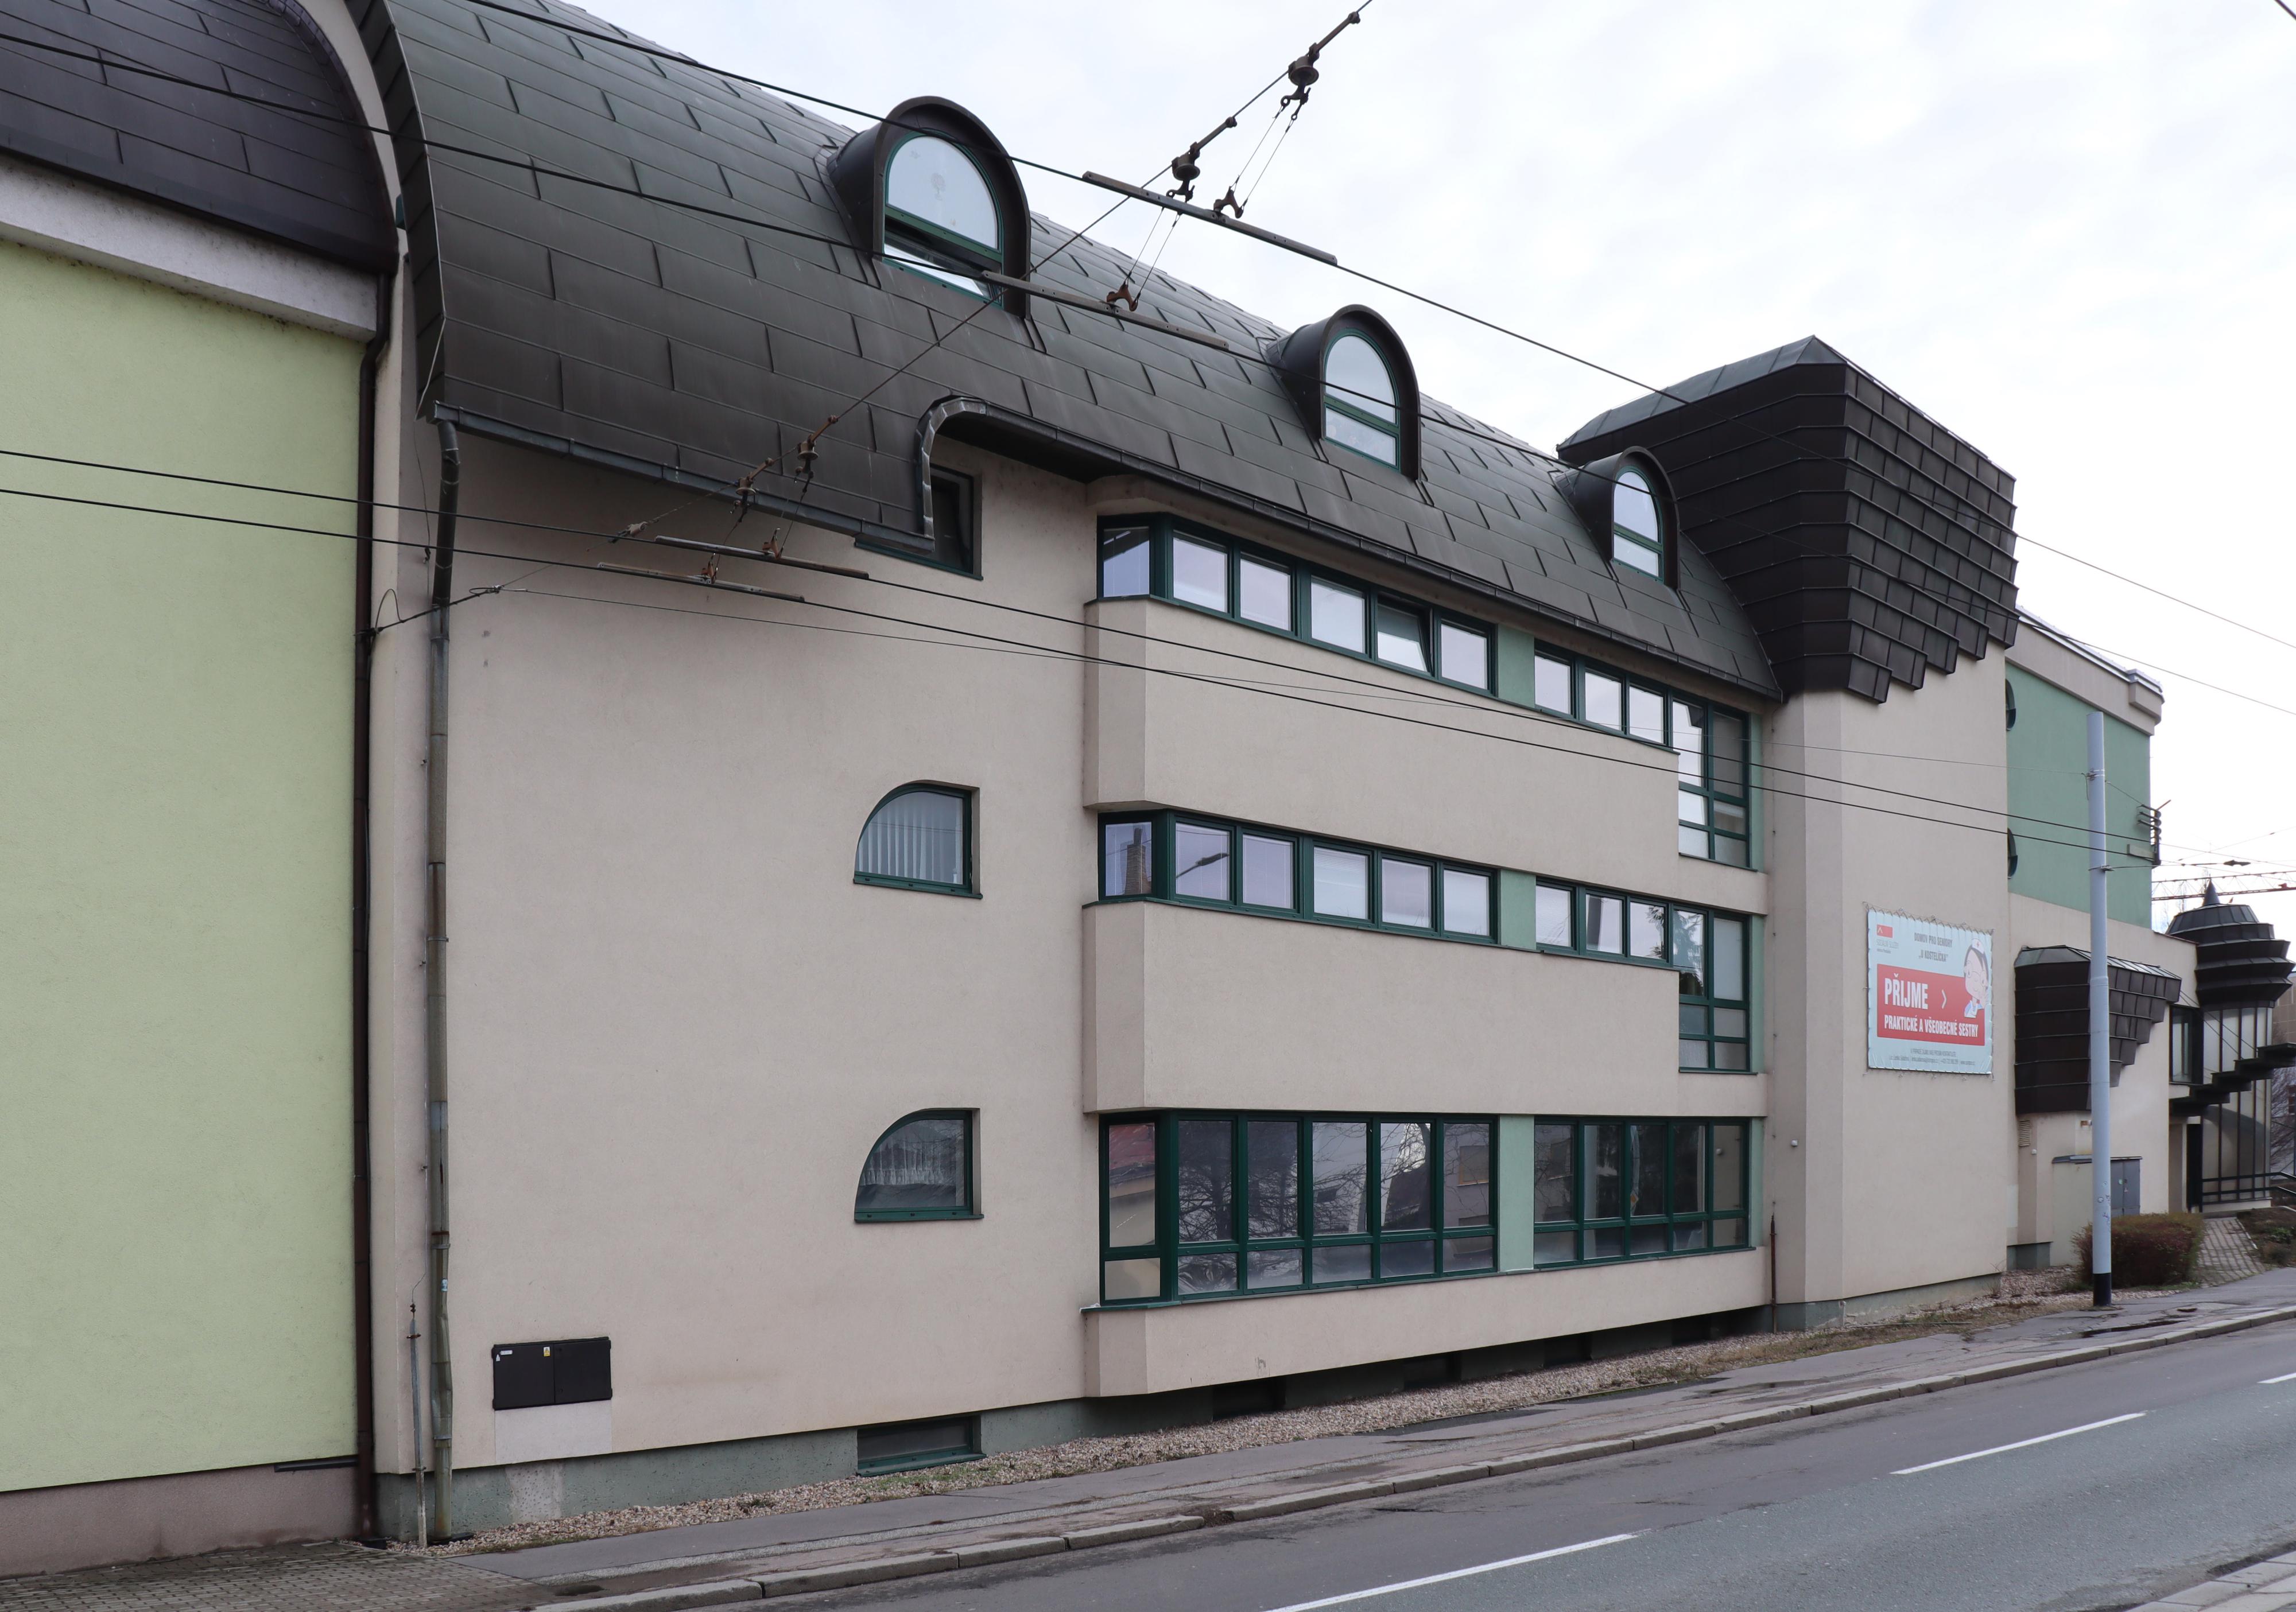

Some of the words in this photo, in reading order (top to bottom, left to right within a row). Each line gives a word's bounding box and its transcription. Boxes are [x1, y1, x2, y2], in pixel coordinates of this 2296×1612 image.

[1914, 932, 1927, 943] DOMOV
[1929, 935, 1937, 945] PRO
[1937, 937, 1953, 947] SENIORY
[1884, 973, 1929, 1009] PŘIJME
[1884, 1014, 1918, 1032] PRAKTICKÉ
[1919, 1019, 1923, 1033] A
[1925, 1016, 1957, 1036] VŠEOBECNÉ
[1958, 1023, 1979, 1038] SESTRY
